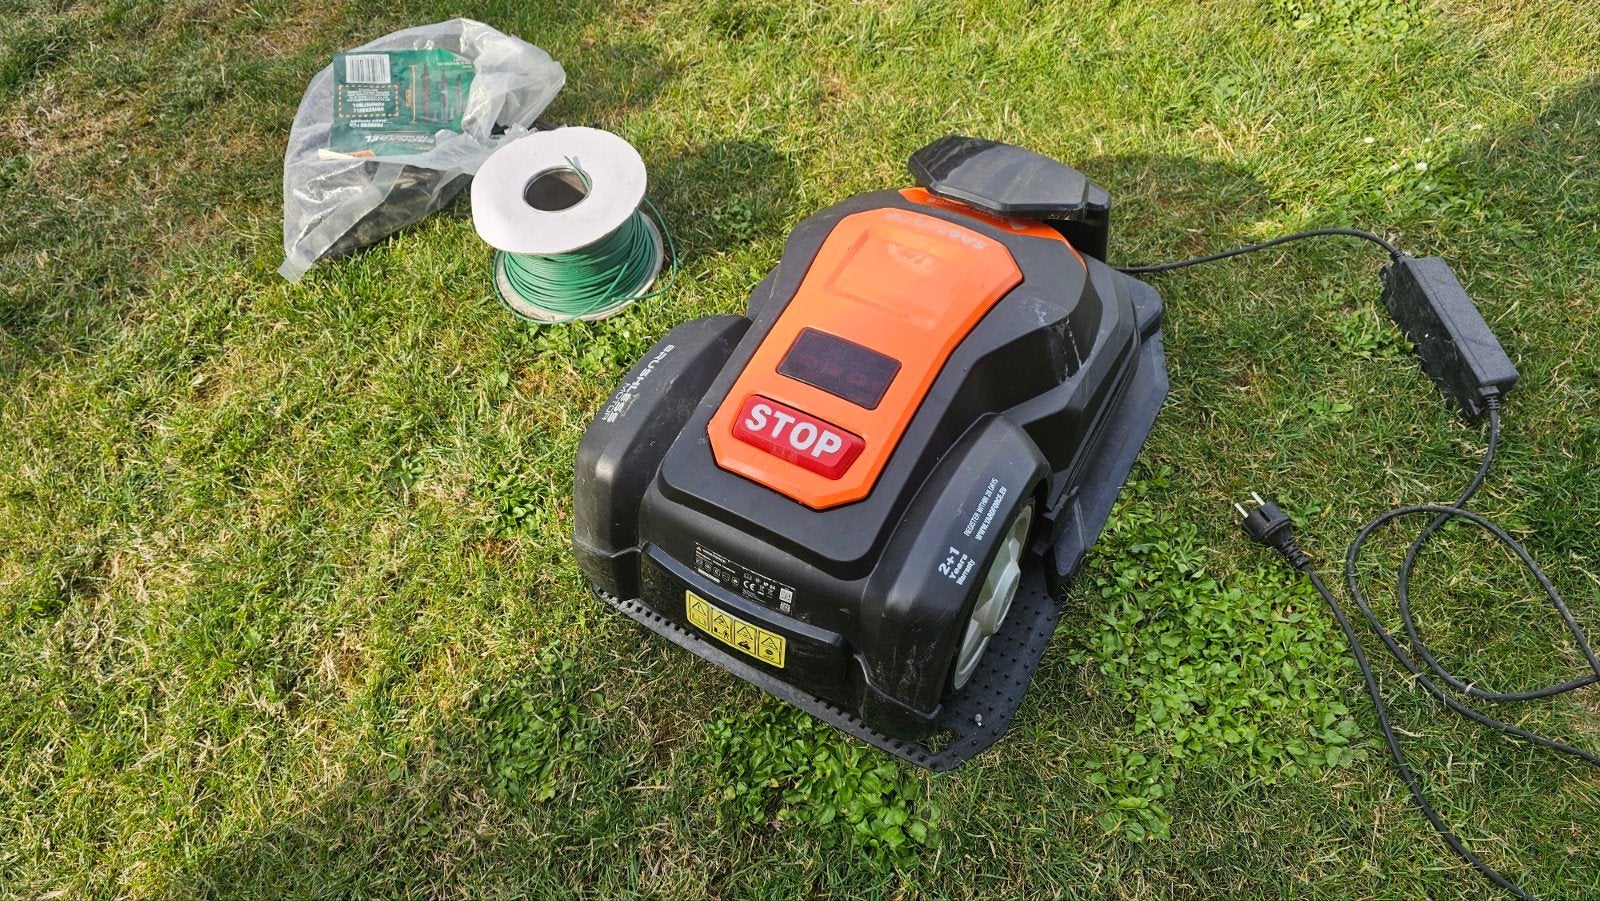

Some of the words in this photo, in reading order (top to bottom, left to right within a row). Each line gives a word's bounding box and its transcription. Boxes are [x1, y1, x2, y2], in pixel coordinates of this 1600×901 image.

[606, 344, 675, 423] BRUSHLESS
[601, 382, 631, 421] MOTOR
[745, 403, 842, 458] STOP
[985, 489, 993, 498] 28
[988, 477, 999, 493] DAYS
[974, 486, 1007, 541] WWW.YARDFORCE.EU
[975, 495, 989, 514] WITHIN
[963, 512, 981, 537] REGISTER
[938, 546, 960, 576] 2+1
[949, 553, 968, 580] Years
[956, 558, 976, 586] Warranty
